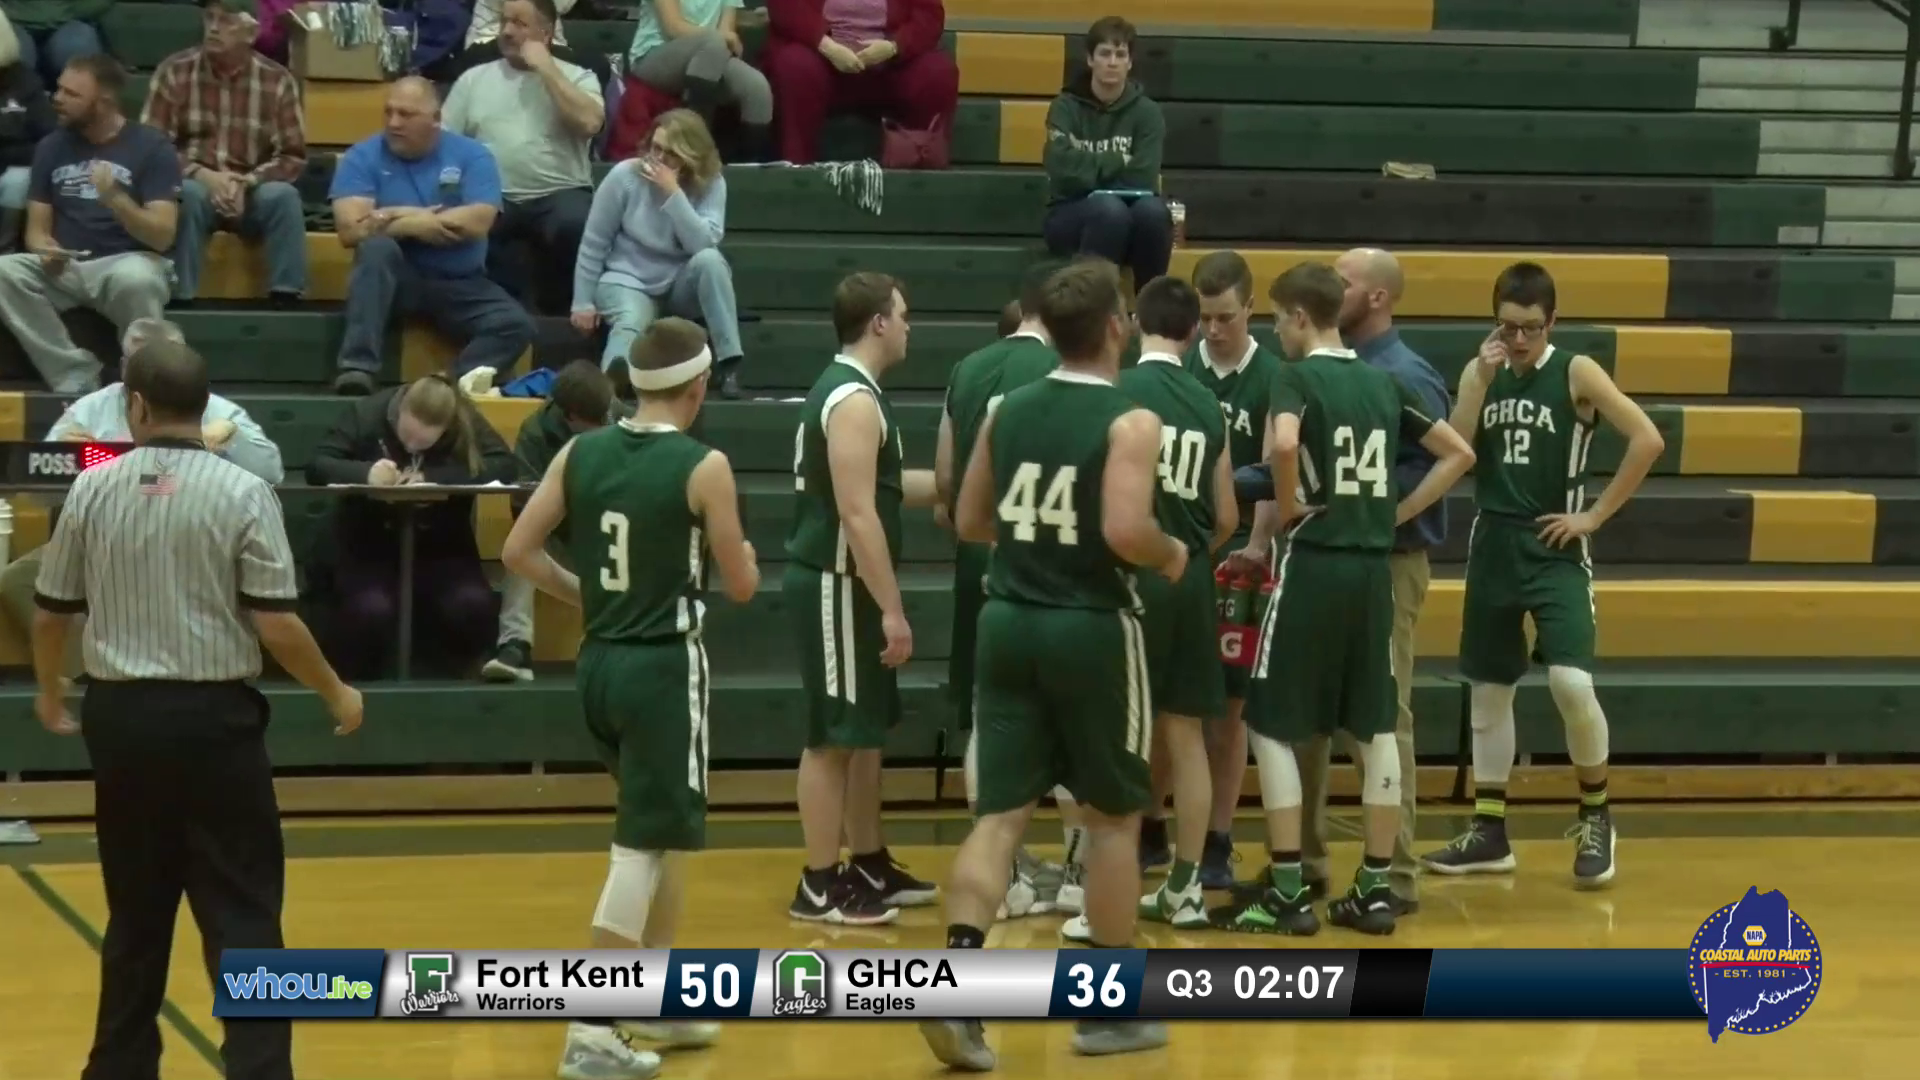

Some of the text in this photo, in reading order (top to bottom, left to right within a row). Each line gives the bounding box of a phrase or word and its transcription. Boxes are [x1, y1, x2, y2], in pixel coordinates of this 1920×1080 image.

[1220, 401, 1252, 436] CA
[1484, 398, 1556, 434] GHCA
[1158, 426, 1206, 500] 40
[1334, 426, 1387, 497] 24
[1503, 429, 1530, 464] 12
[998, 462, 1078, 545] 44
[600, 510, 629, 592] 3
[1220, 632, 1243, 658] G
